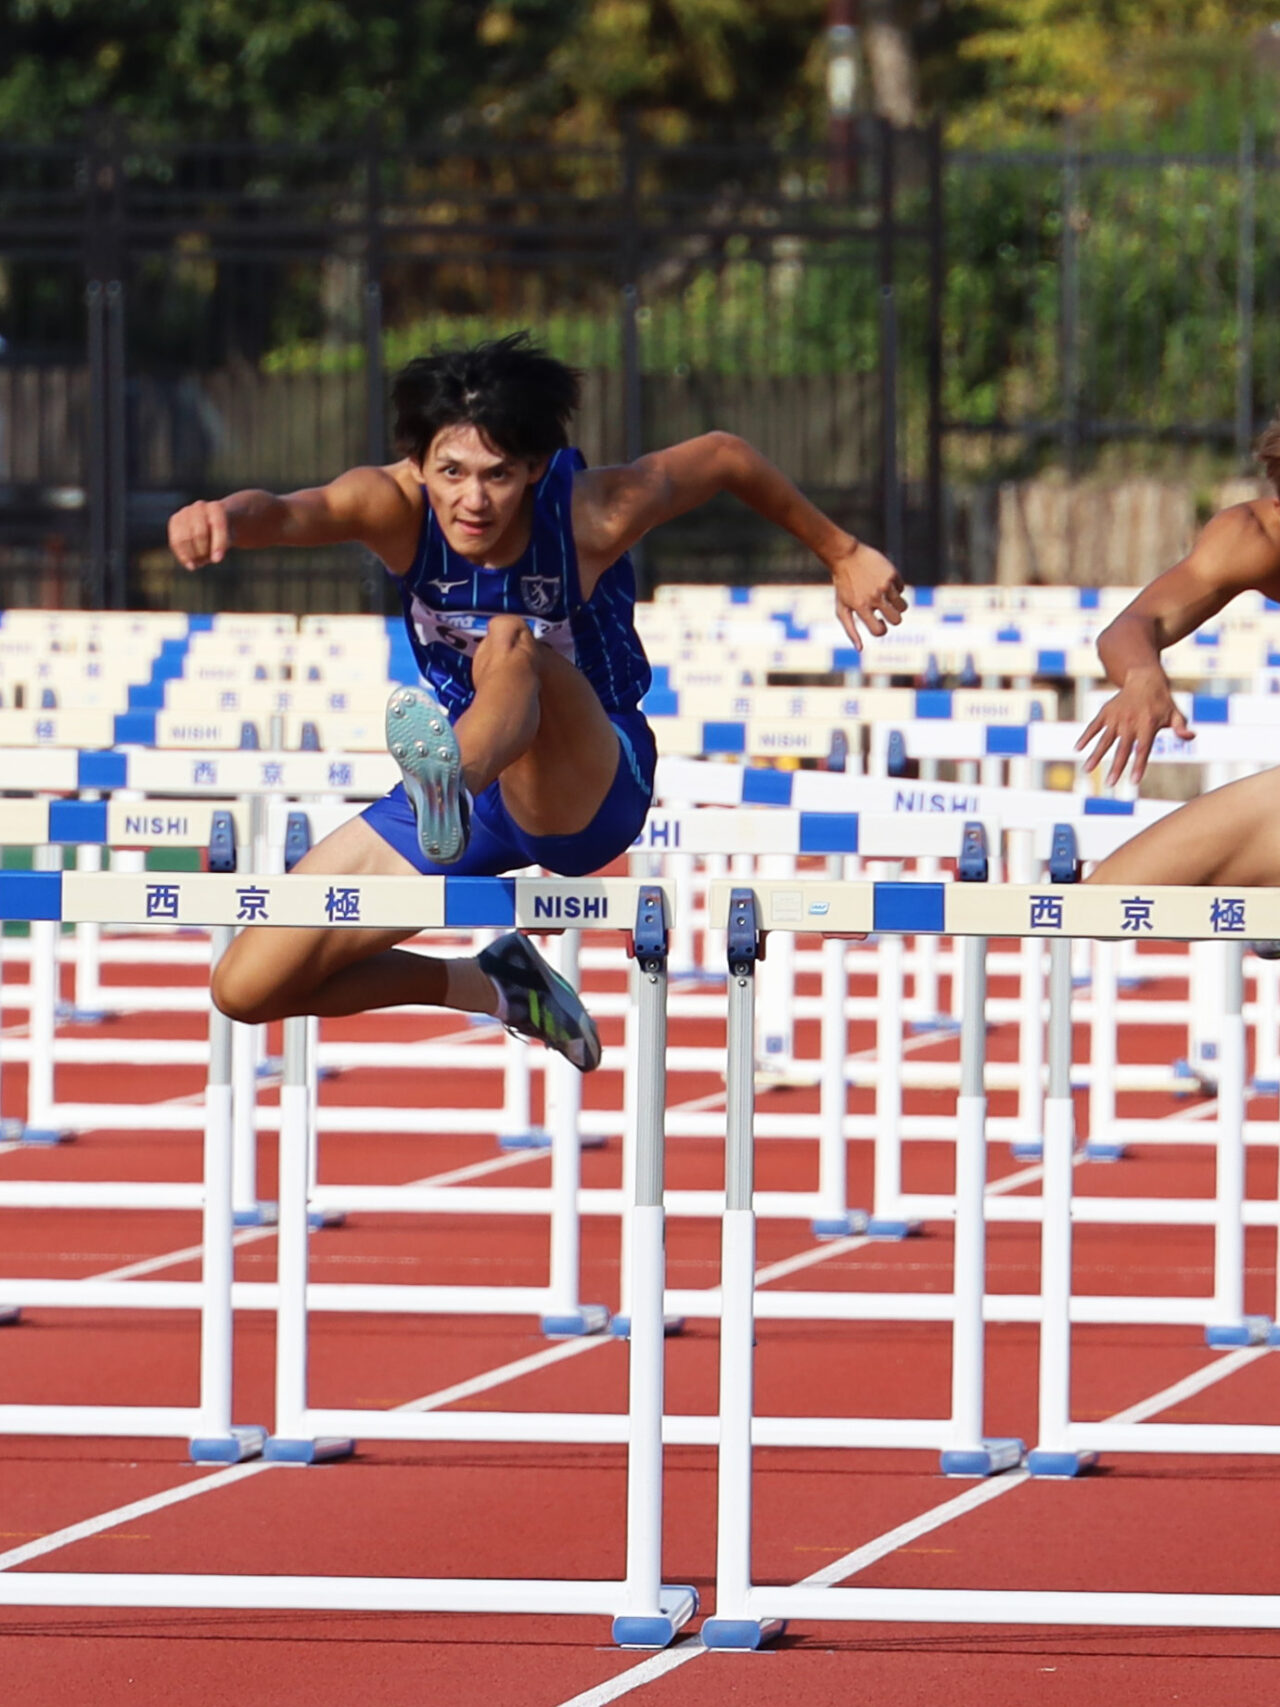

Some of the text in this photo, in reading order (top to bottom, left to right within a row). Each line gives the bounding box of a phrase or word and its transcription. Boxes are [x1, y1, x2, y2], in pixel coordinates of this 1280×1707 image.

[125, 816, 188, 835] NISHI
[146, 884, 360, 922] 西京極
[534, 896, 608, 919] NISHI
[1028, 895, 1246, 934] 西京極
